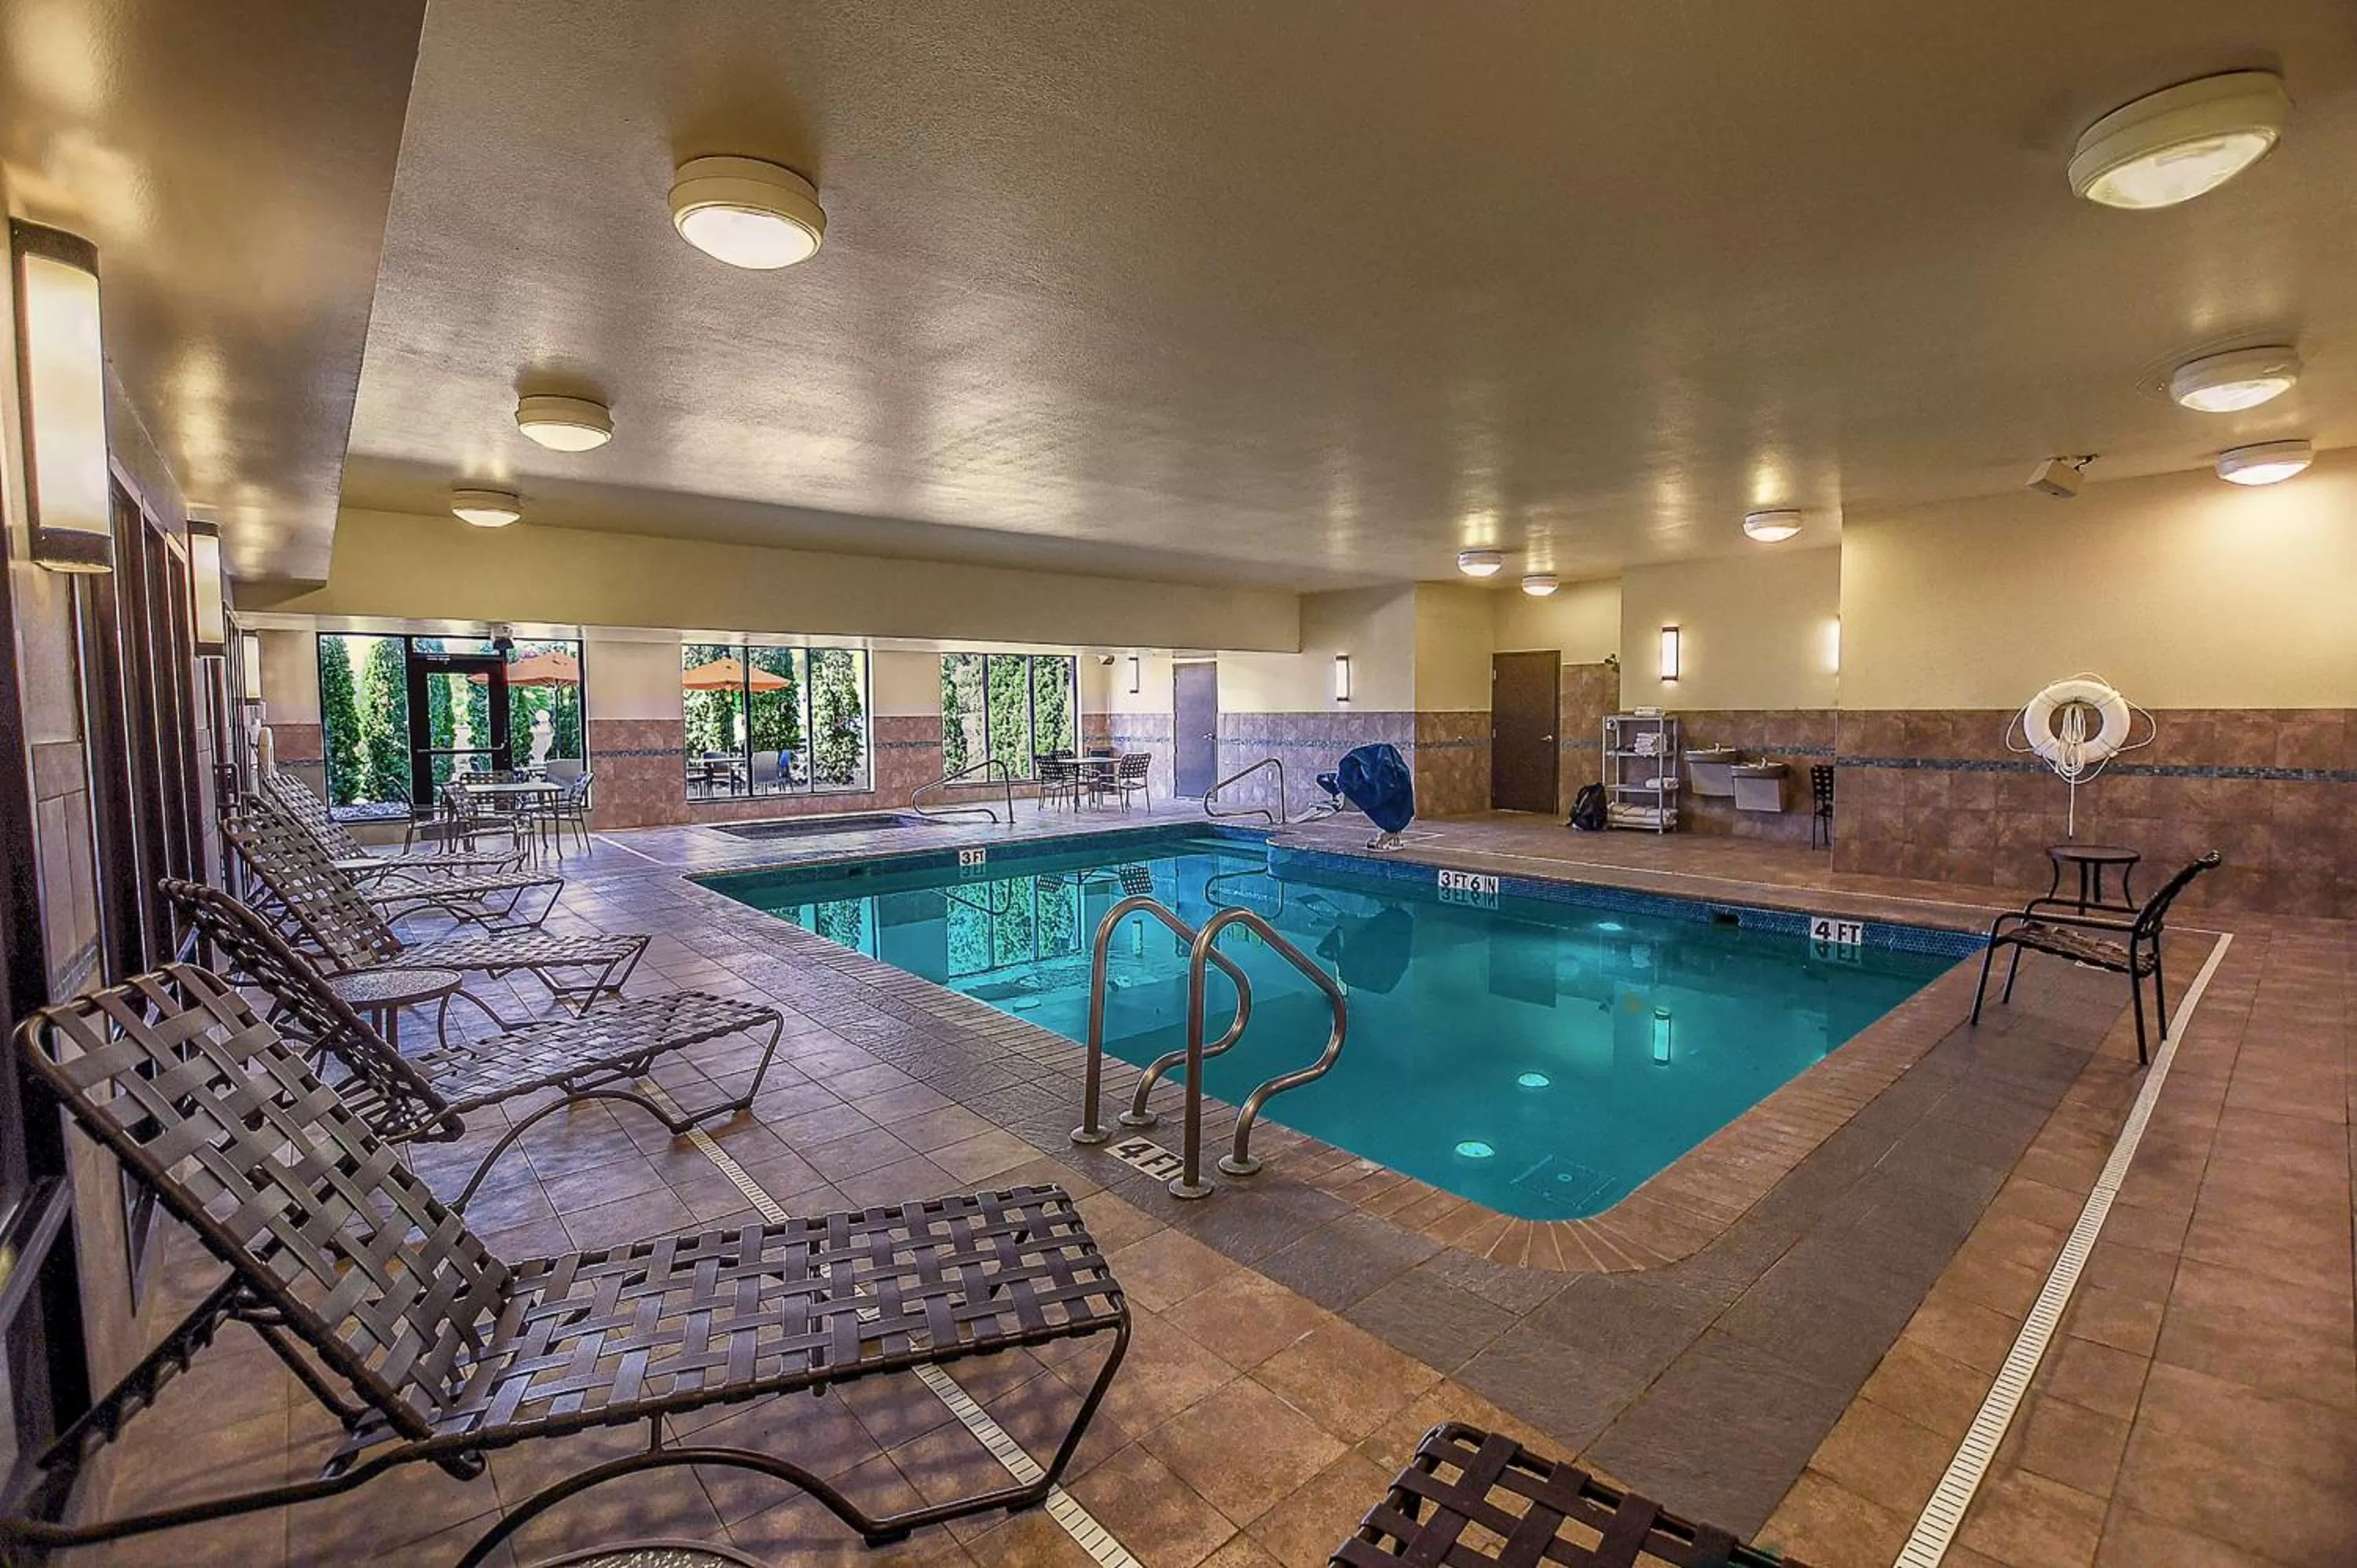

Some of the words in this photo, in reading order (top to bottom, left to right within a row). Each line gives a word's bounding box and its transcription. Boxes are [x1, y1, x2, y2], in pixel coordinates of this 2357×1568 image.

[962, 852, 971, 864] 3
[973, 850, 984, 863] FT
[1441, 872, 1451, 886] 3
[1454, 874, 1468, 888] FT
[1470, 876, 1480, 890] 6
[1484, 877, 1496, 893] IN
[1815, 921, 1831, 940] 4
[1117, 1143, 1156, 1160] 4
